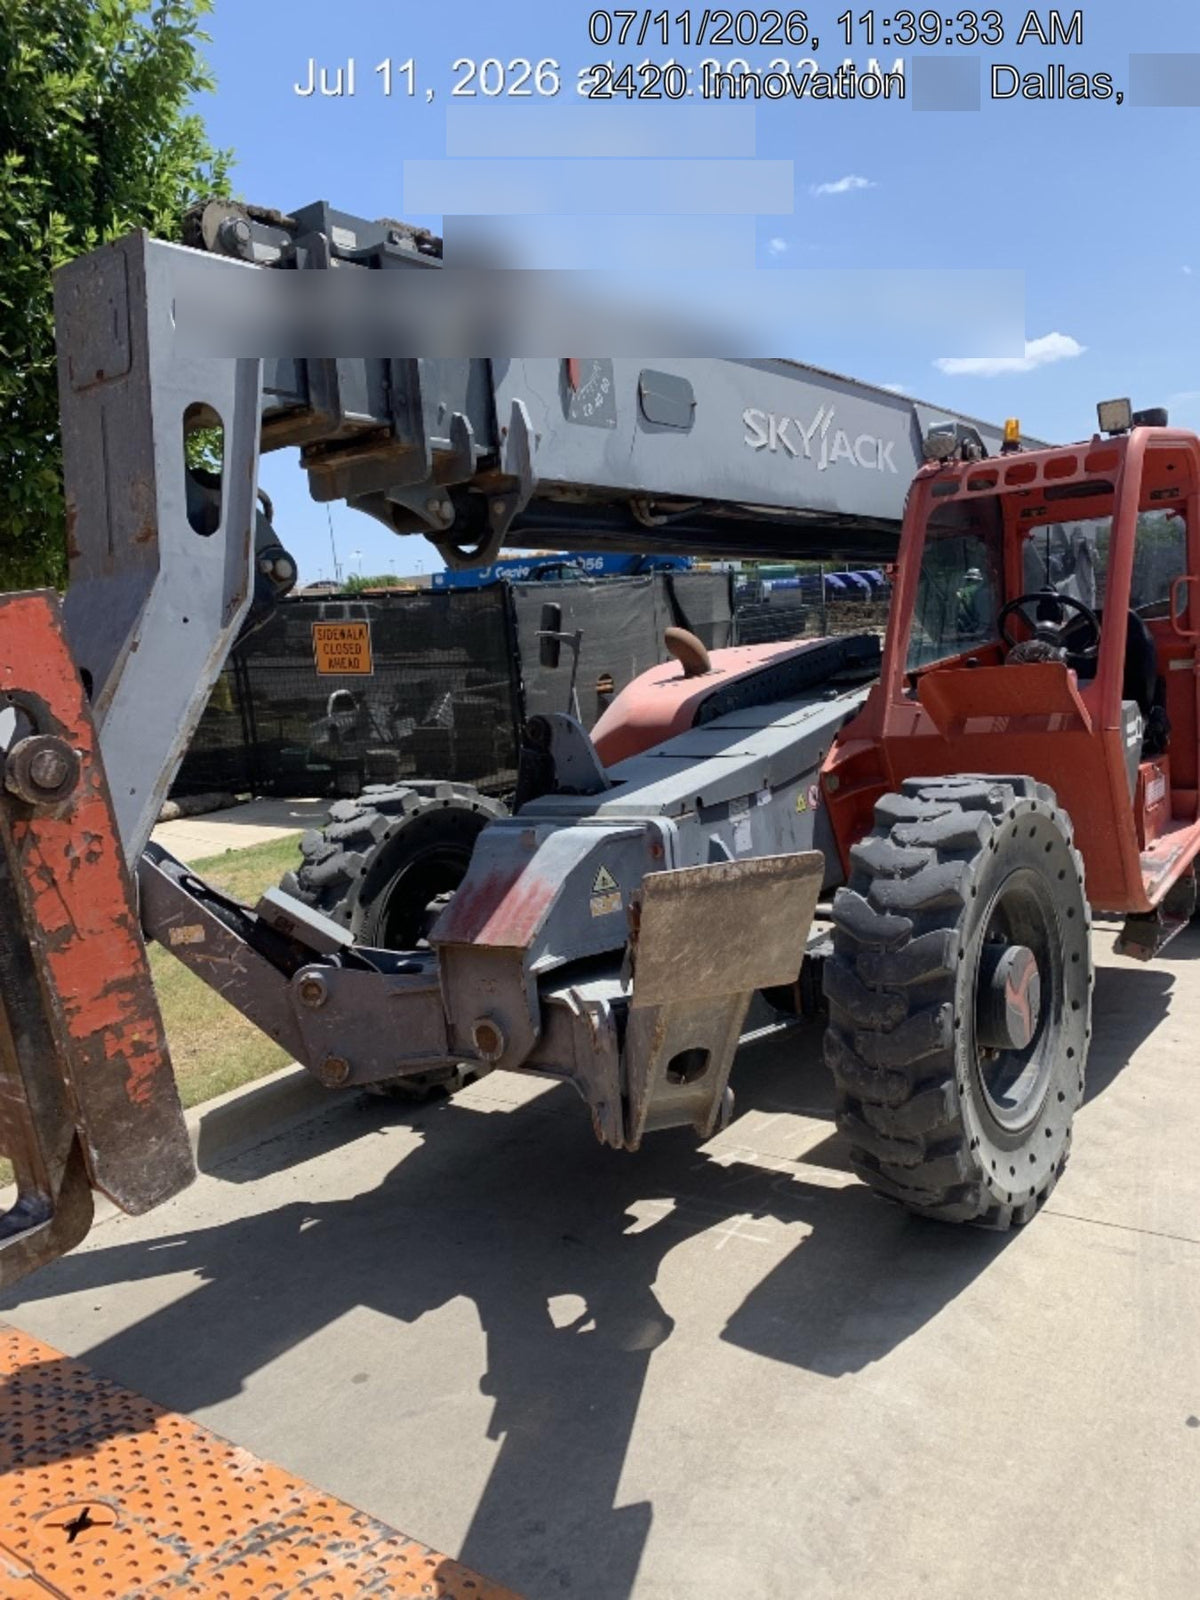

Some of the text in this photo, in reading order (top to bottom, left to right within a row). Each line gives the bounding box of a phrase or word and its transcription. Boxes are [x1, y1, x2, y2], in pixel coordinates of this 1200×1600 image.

[742, 403, 898, 474] SKYJACK
[317, 627, 365, 641] SIDEWALK
[323, 643, 362, 655] CLOSED
[328, 657, 360, 669] AHEAD
